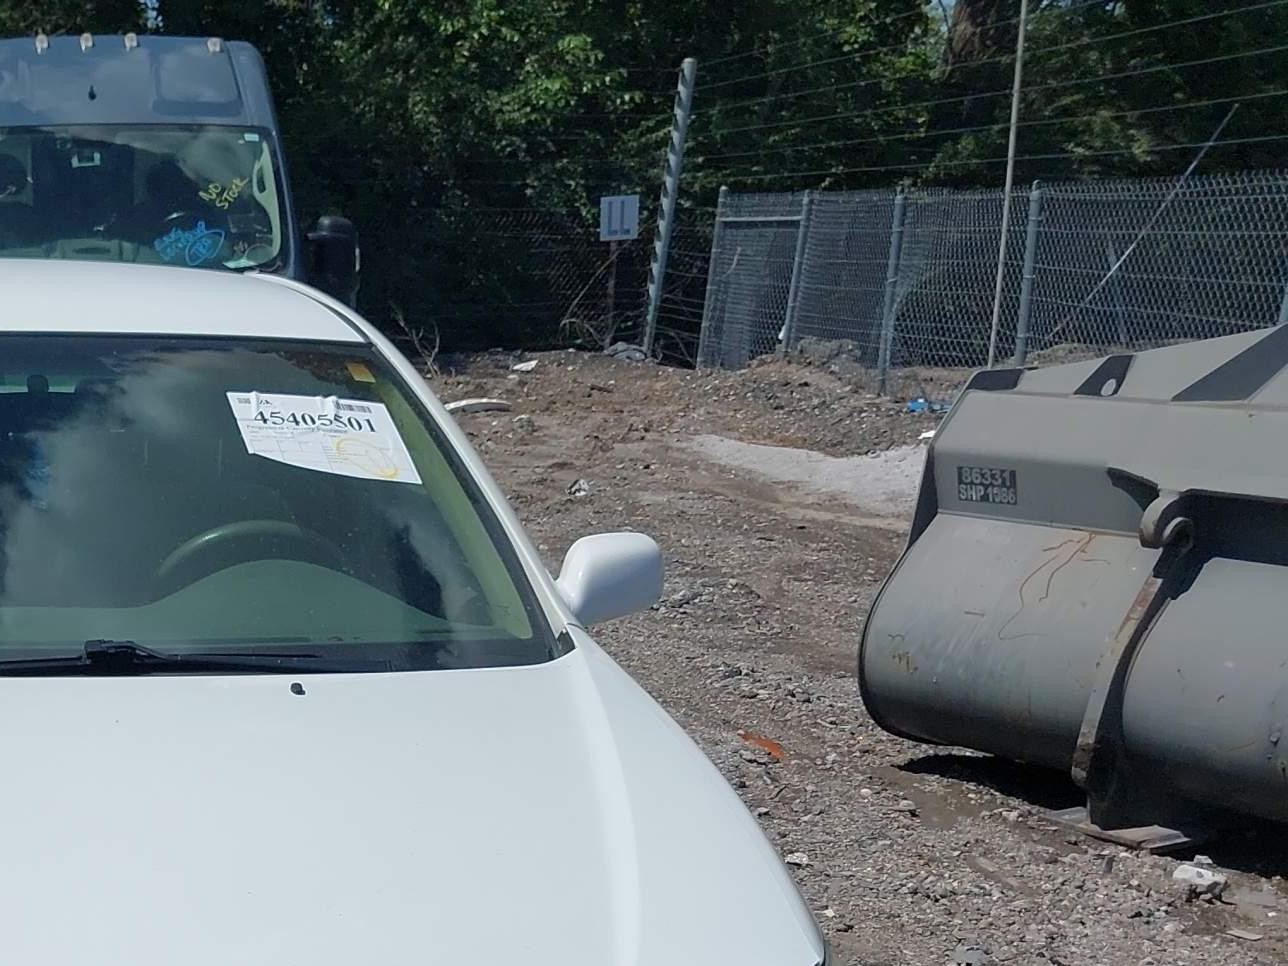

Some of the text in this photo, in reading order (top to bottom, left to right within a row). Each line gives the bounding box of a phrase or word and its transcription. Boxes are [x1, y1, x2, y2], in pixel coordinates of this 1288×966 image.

[254, 410, 377, 434] 45405501
[962, 466, 1011, 488] 86331
[959, 483, 985, 502] SHP
